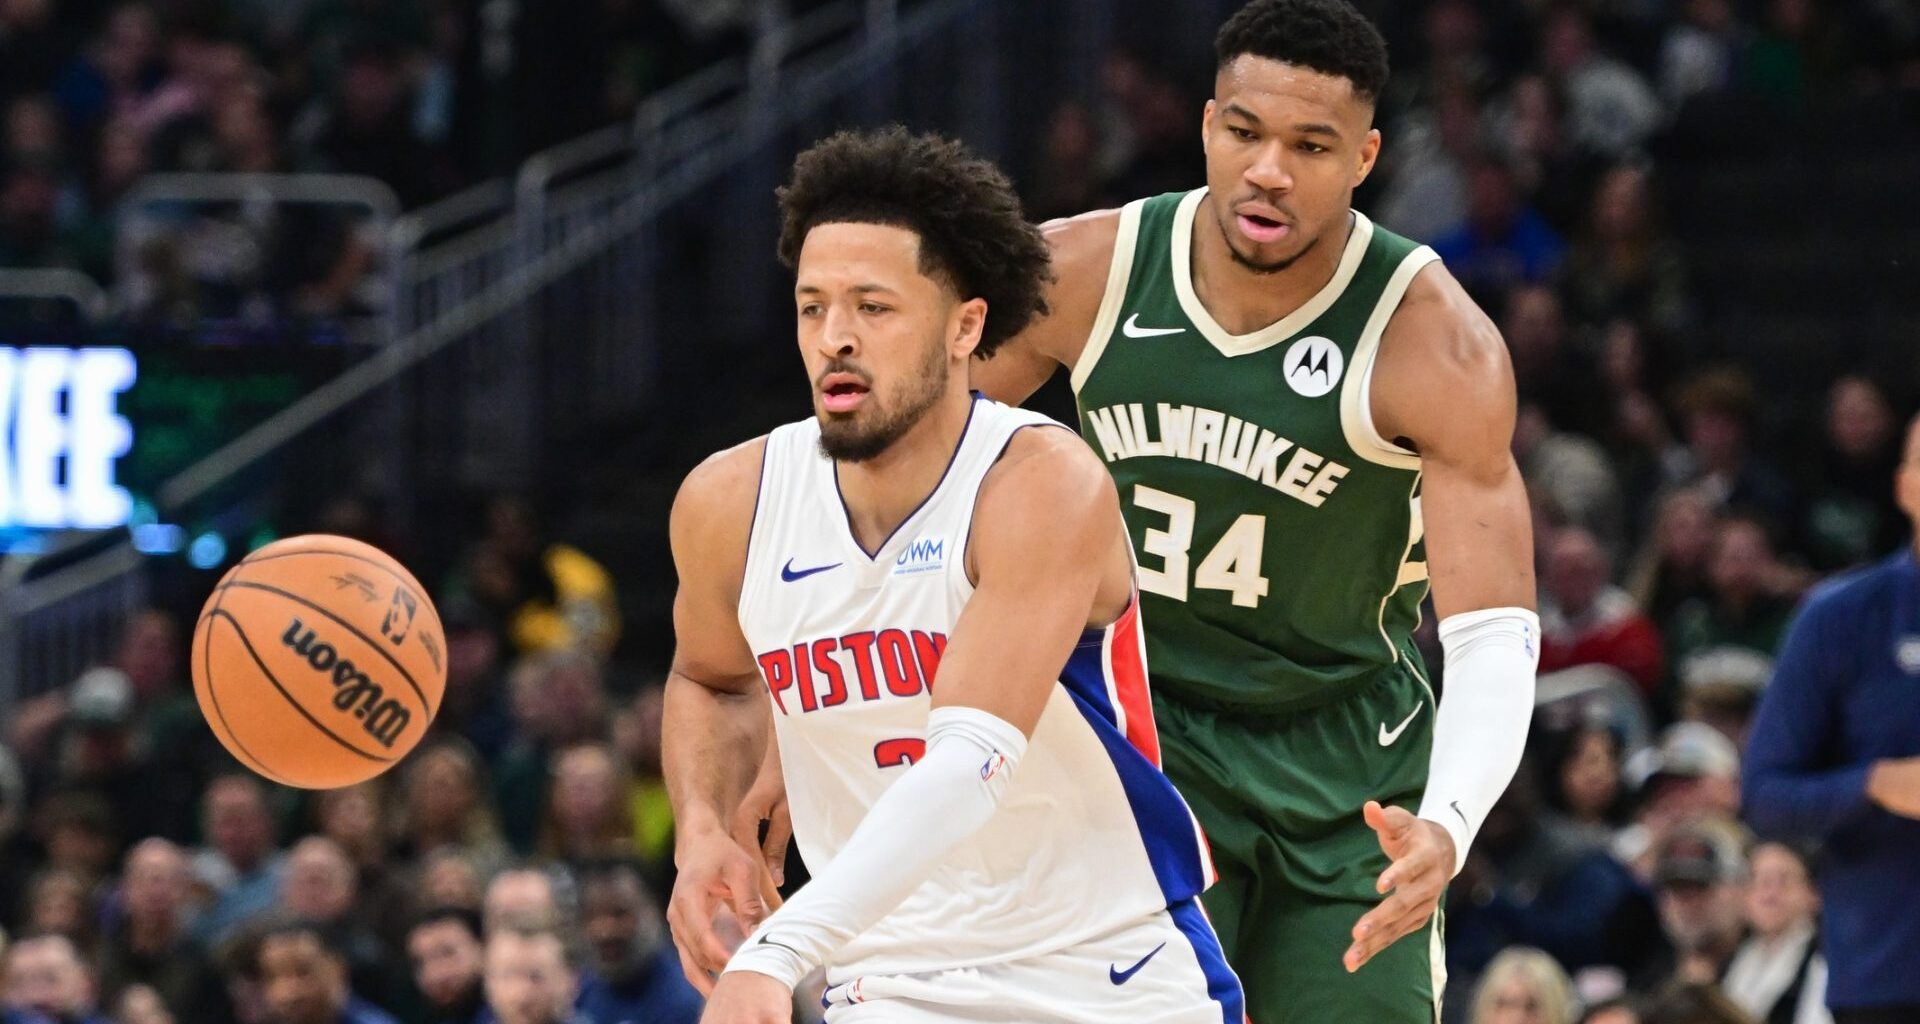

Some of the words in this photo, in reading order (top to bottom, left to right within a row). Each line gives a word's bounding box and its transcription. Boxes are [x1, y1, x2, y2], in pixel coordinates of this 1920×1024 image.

[0, 346, 136, 528] EE
[1087, 403, 1350, 507] MILWAUKEE
[1133, 484, 1269, 608] 34
[283, 618, 411, 748] Wilson
